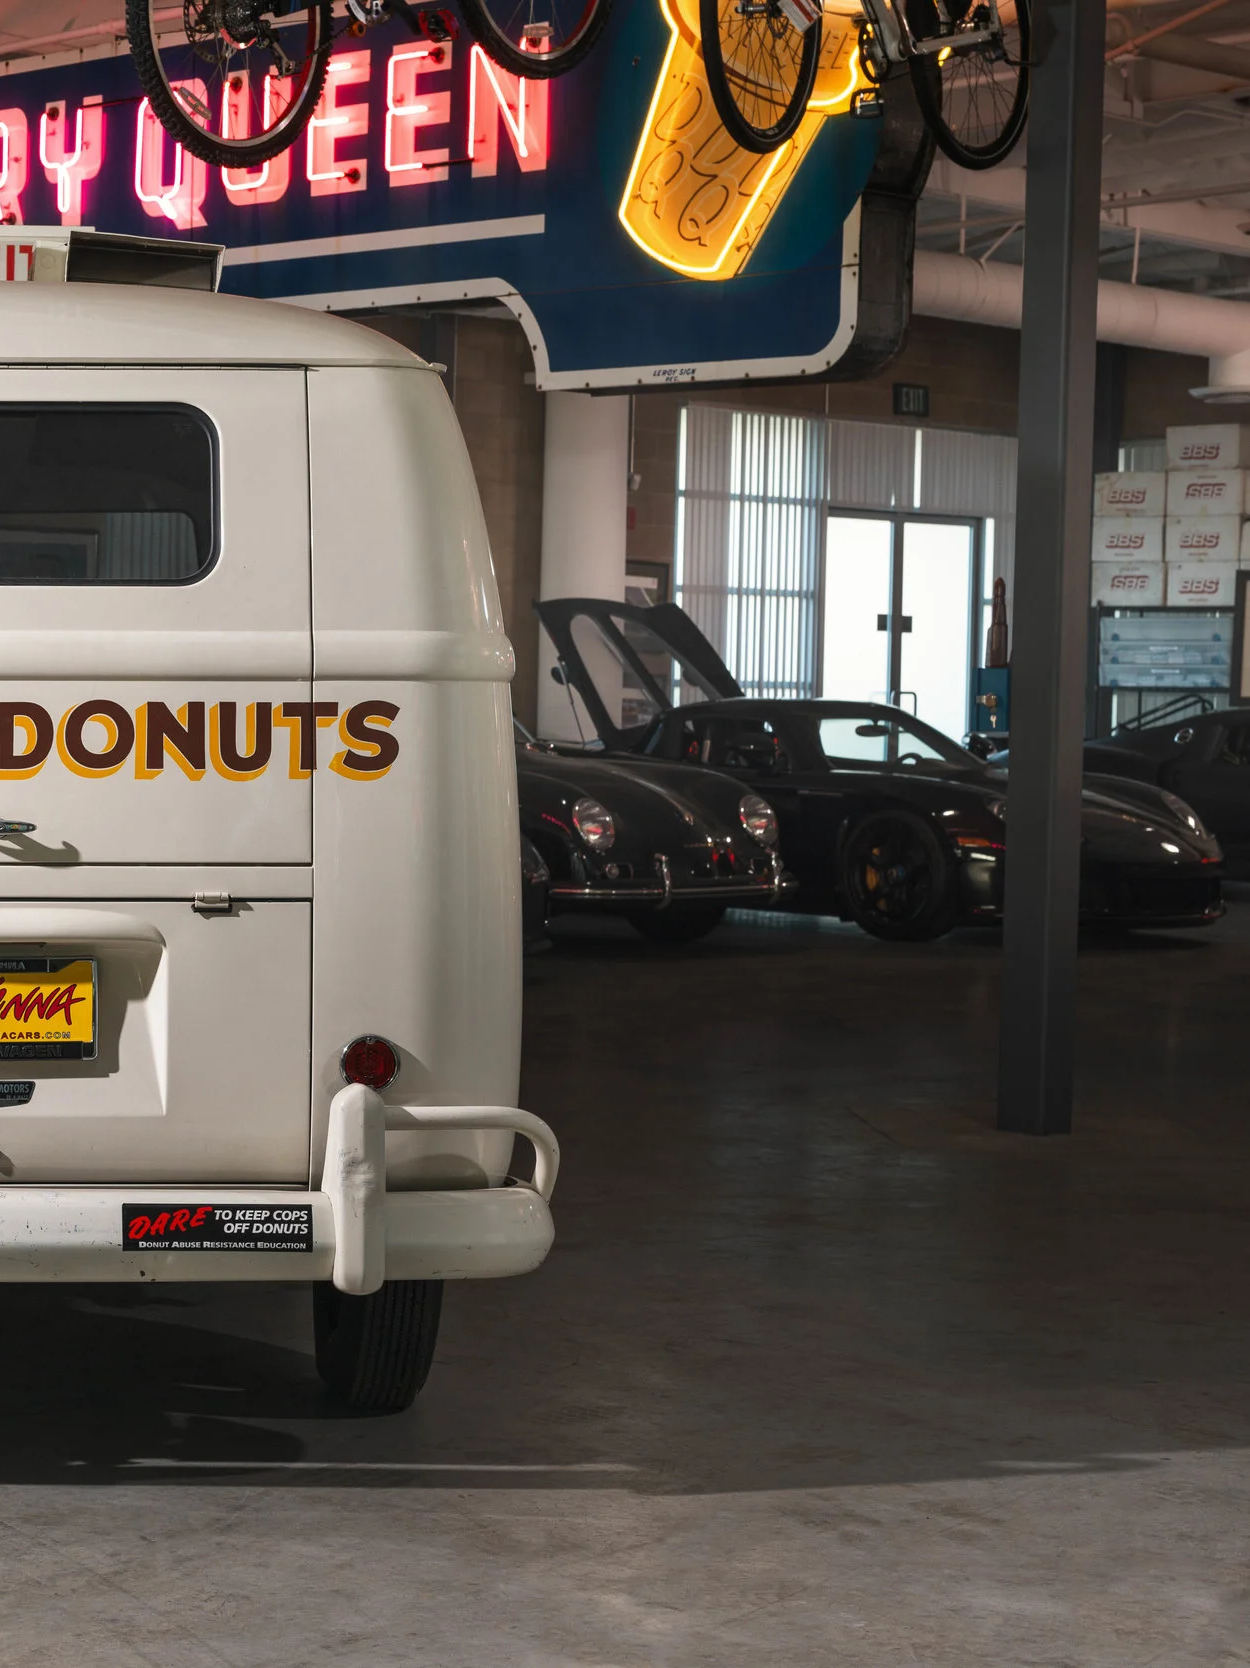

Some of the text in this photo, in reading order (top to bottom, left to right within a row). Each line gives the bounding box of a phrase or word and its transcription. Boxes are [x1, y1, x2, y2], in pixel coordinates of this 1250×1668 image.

[135, 22, 551, 230] QUEEN
[679, 368, 697, 376] SIGN
[1180, 443, 1221, 460] BBS
[1107, 488, 1147, 504] BBS
[1185, 483, 1227, 499] BBS
[1105, 533, 1146, 549] BBS
[1179, 532, 1221, 549] BBS
[1110, 575, 1150, 591] BBS
[1178, 578, 1220, 595] BBS
[128, 1206, 308, 1240] DARE TO KEEP COPS
[223, 1223, 308, 1235] OFF DONUTS
